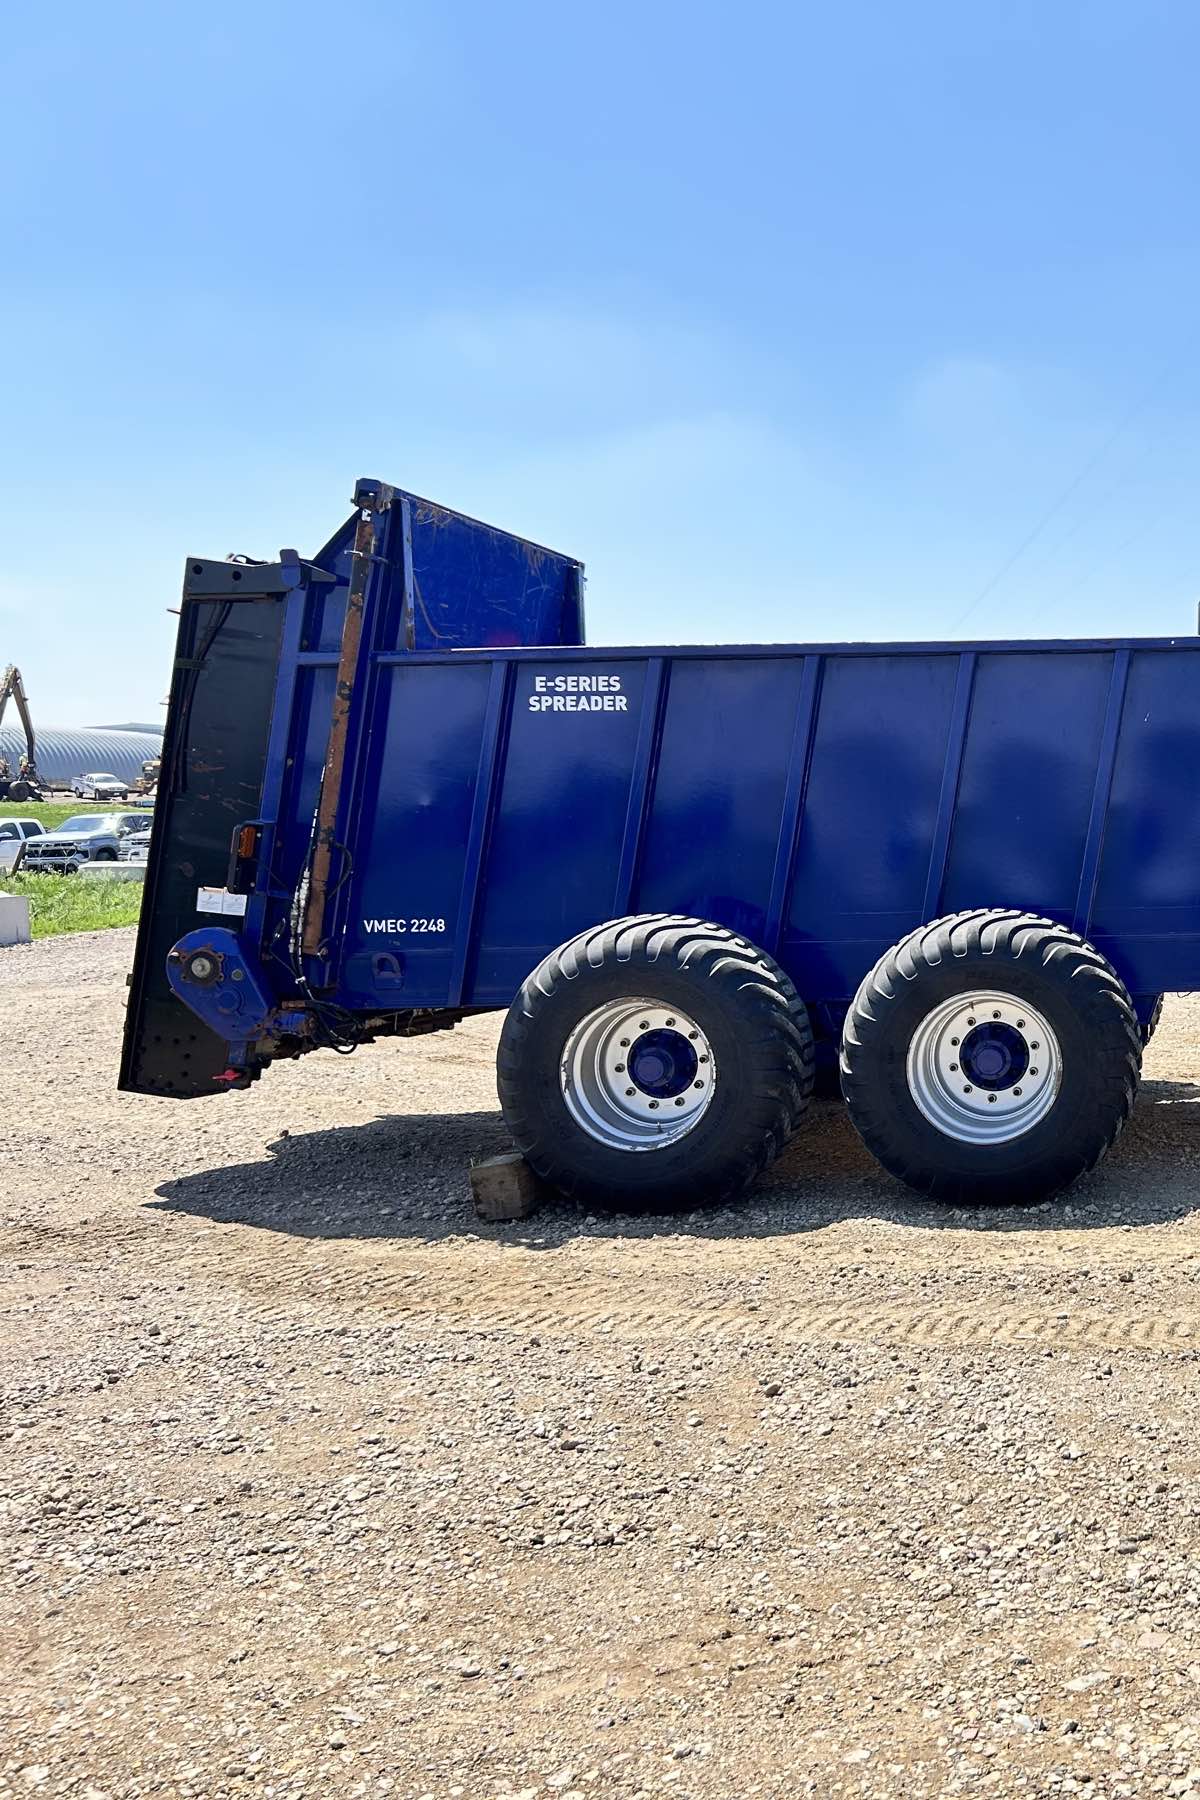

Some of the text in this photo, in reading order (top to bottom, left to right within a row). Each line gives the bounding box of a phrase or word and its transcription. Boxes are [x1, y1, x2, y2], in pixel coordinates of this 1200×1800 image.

[535, 675, 621, 692] E-SERIES
[528, 695, 628, 712] SPREADER
[363, 918, 446, 933] VMEC 2248
